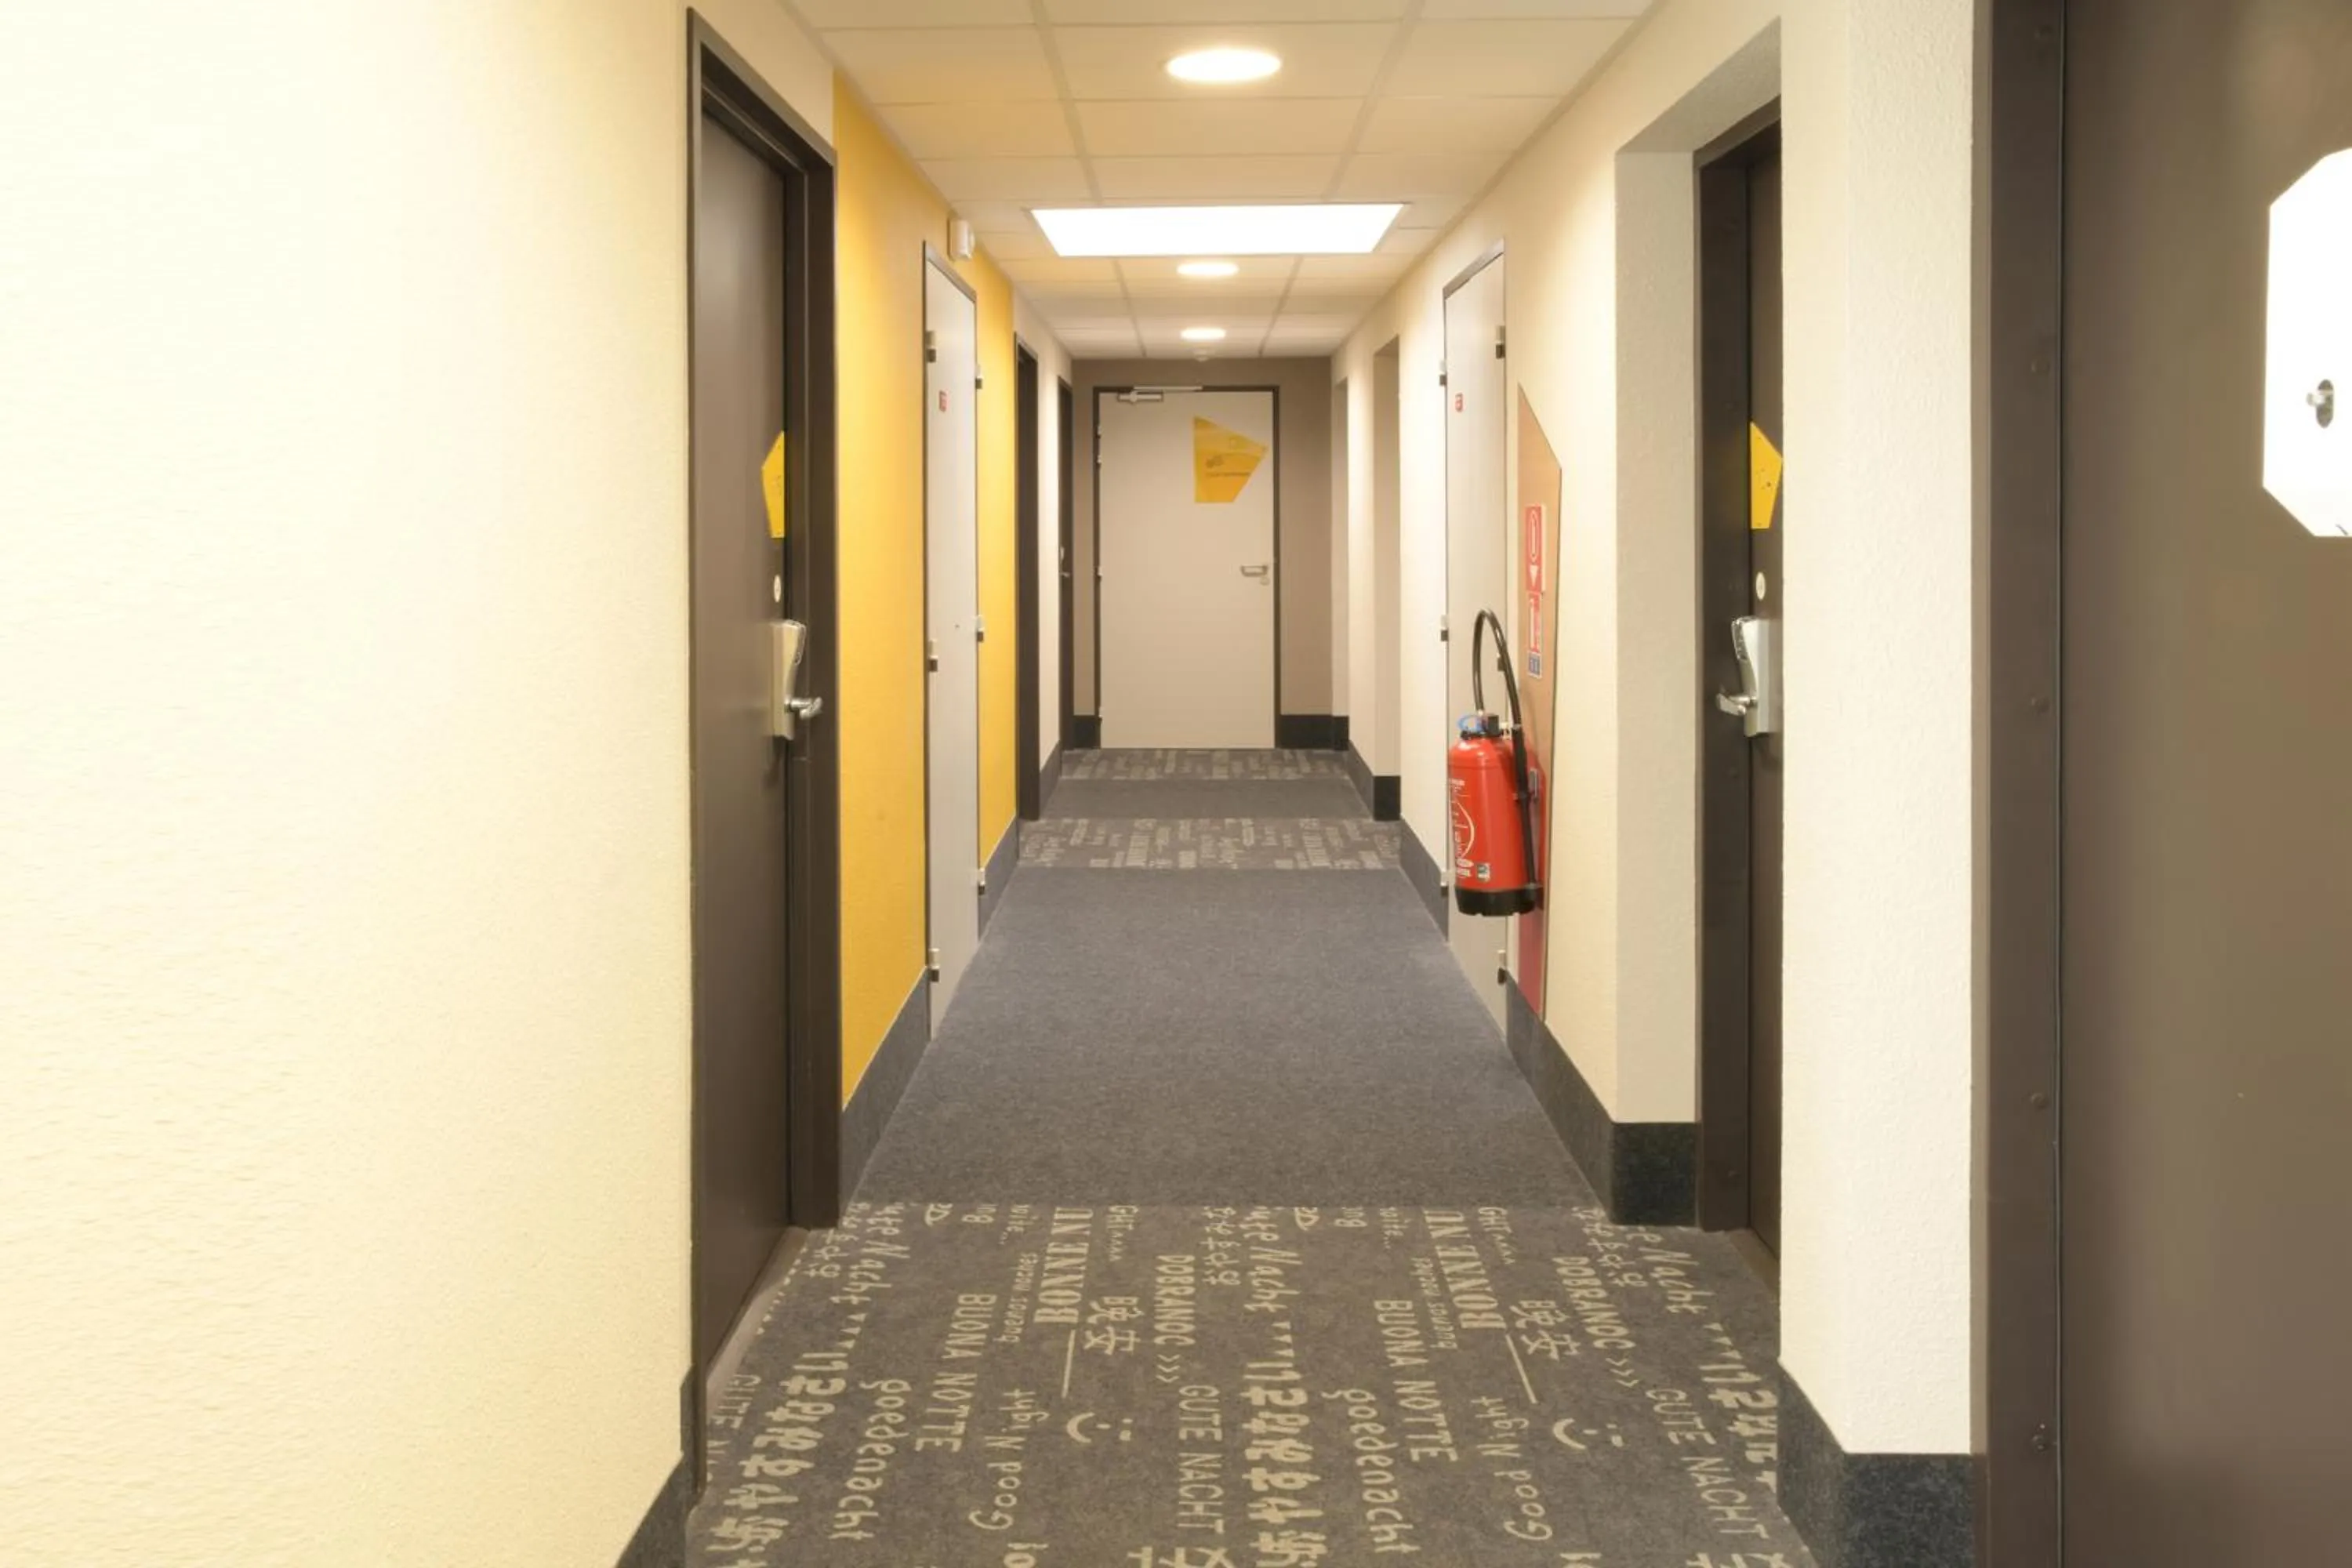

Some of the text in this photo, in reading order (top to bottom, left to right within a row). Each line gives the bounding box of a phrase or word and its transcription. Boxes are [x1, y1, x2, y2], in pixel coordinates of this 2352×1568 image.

[829, 1240, 911, 1305] Nacht
[1033, 1241, 1090, 1324] BONNE
[1153, 1254, 1196, 1346] DOBRANOC
[1243, 1247, 1302, 1312] Nacht
[1437, 1245, 1507, 1328] BONNE
[1552, 1256, 1636, 1349] DOBRANOC
[1639, 1247, 1715, 1315] Nacht
[914, 1293, 998, 1453] BUONA NOTTE
[1178, 1384, 1223, 1441] GUTE
[1373, 1299, 1460, 1463] BUONA NOTTE
[1645, 1388, 1717, 1446] GUTE
[827, 1378, 913, 1541] goedenacht
[967, 1388, 1051, 1531] Good Night
[1177, 1452, 1225, 1535] NACHT
[1320, 1388, 1420, 1553] goedenacht
[1470, 1396, 1553, 1541] Good Night
[1680, 1456, 1770, 1540] NACHT
